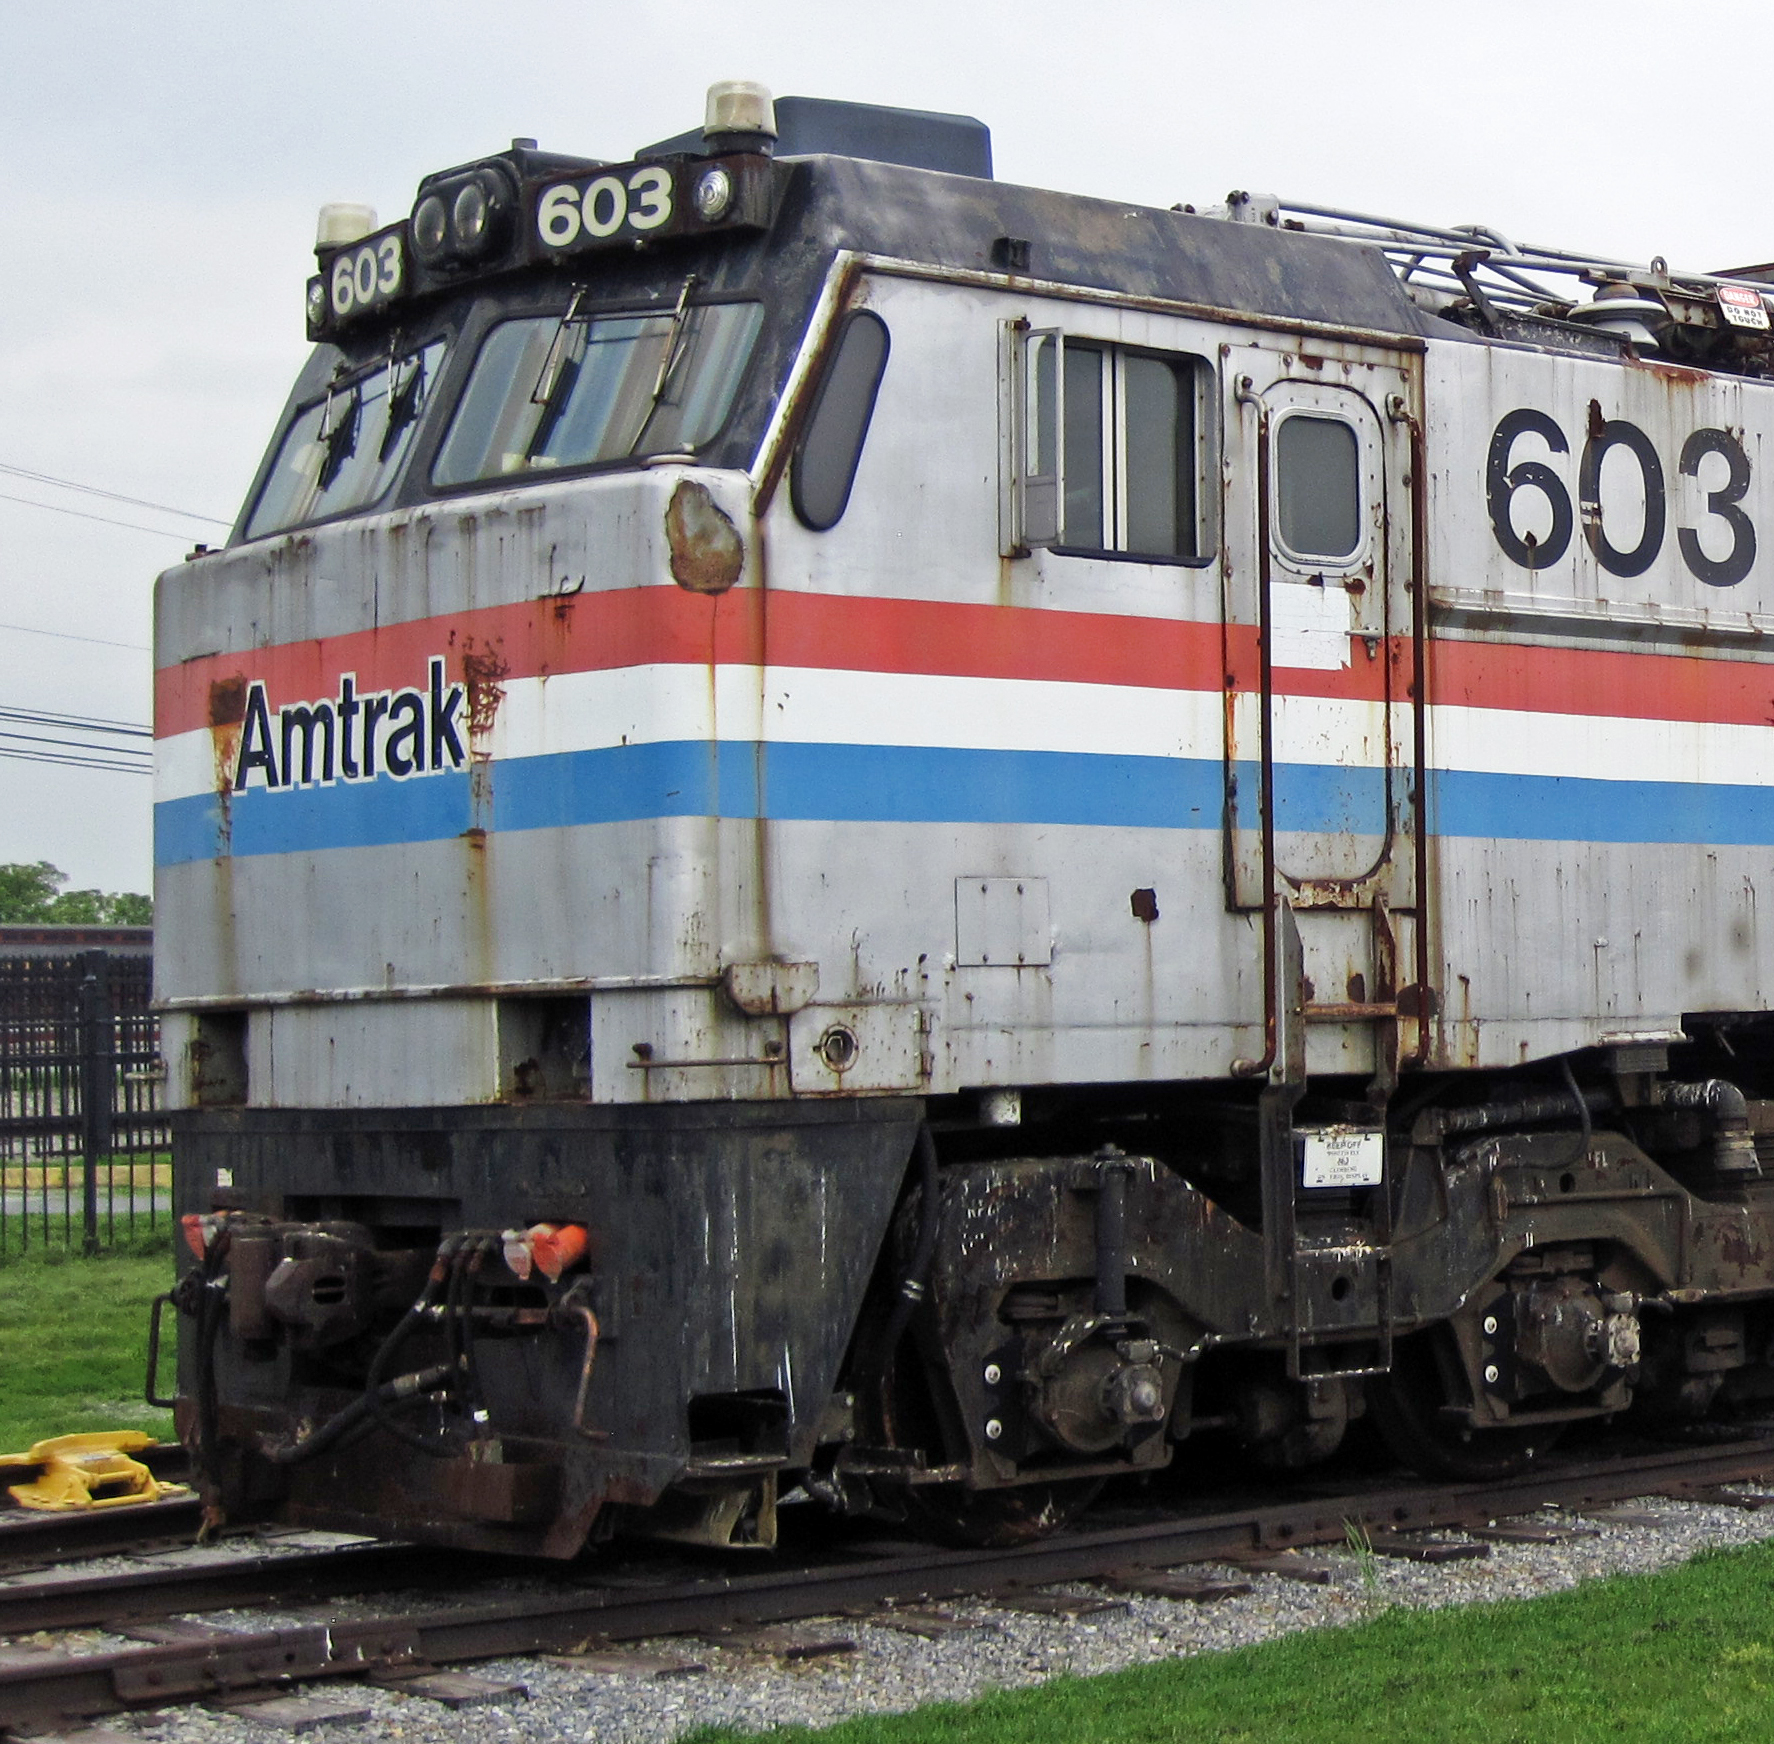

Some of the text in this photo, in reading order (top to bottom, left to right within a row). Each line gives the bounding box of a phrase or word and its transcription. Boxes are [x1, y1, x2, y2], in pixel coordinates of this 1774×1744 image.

[537, 166, 674, 248] 603
[331, 235, 403, 316] 603
[1722, 290, 1756, 305] DANGER
[1726, 305, 1762, 318] DO NOT
[1732, 314, 1764, 327] TOUCH
[1486, 407, 1757, 587] 603
[233, 656, 467, 794] Amtrak
